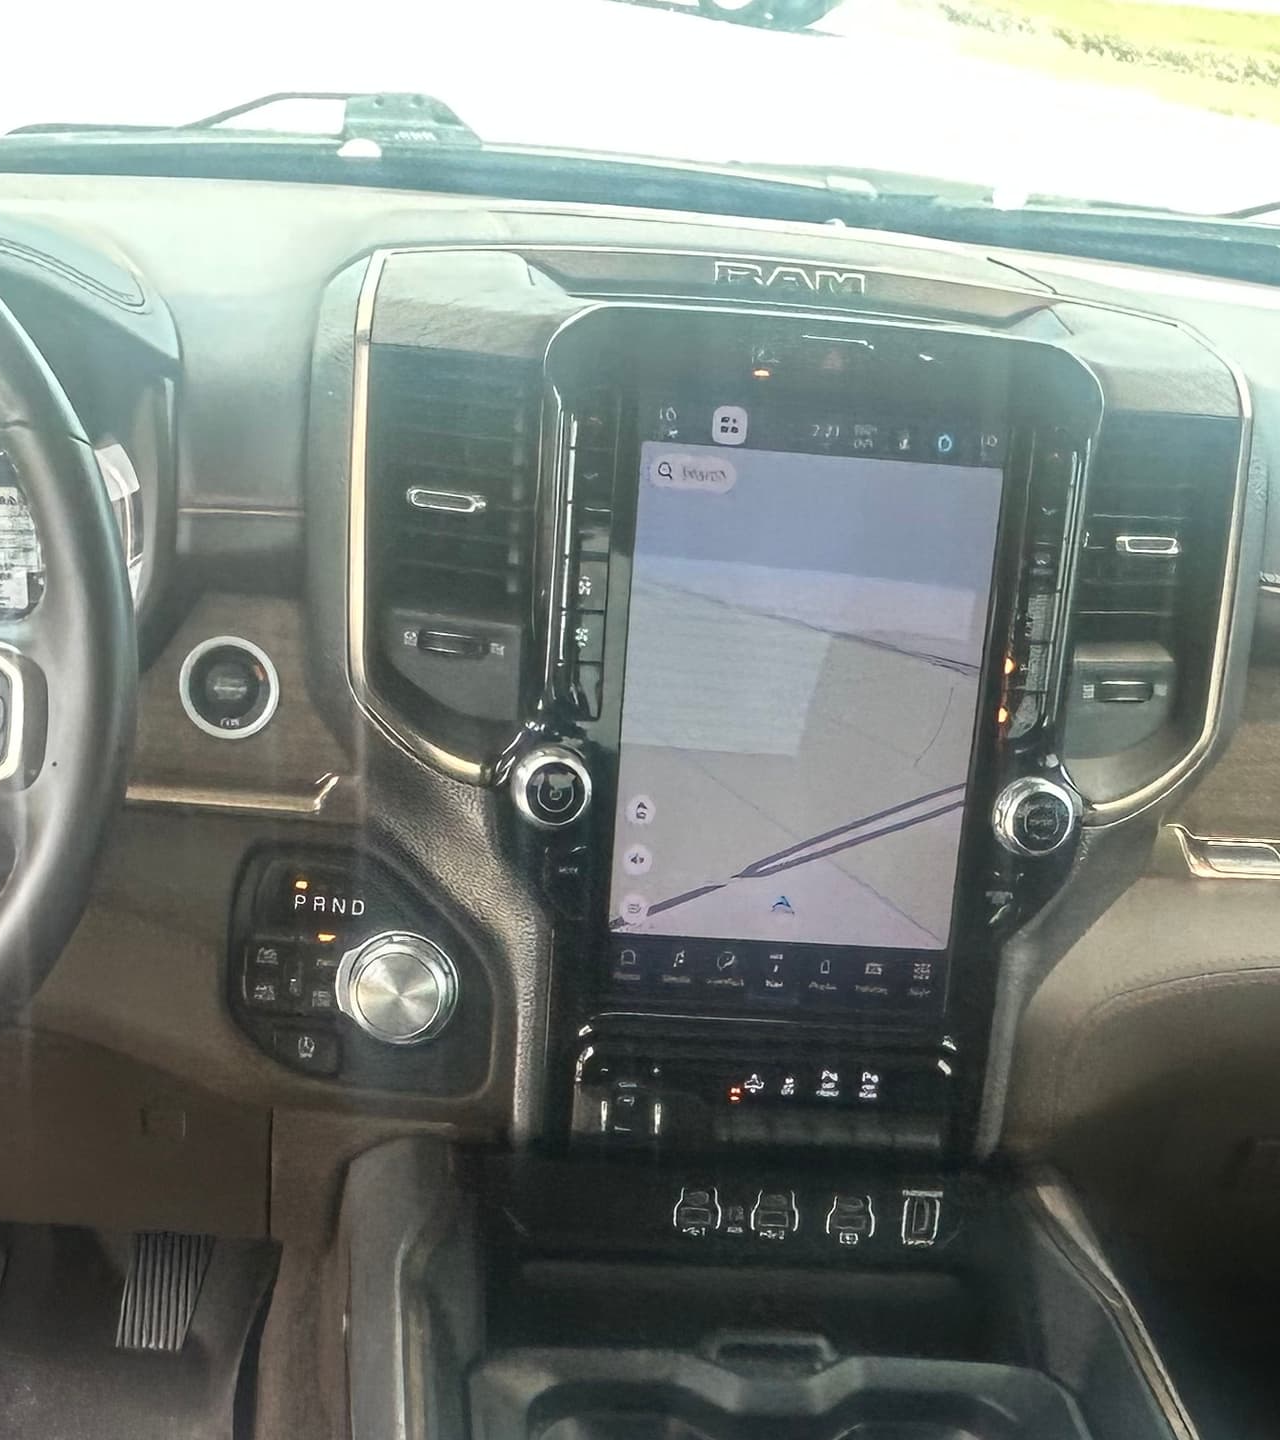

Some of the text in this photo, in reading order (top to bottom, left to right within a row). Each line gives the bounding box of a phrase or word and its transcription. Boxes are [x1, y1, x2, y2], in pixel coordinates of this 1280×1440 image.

[714, 262, 865, 295] RAM
[294, 894, 365, 916] P R N D
